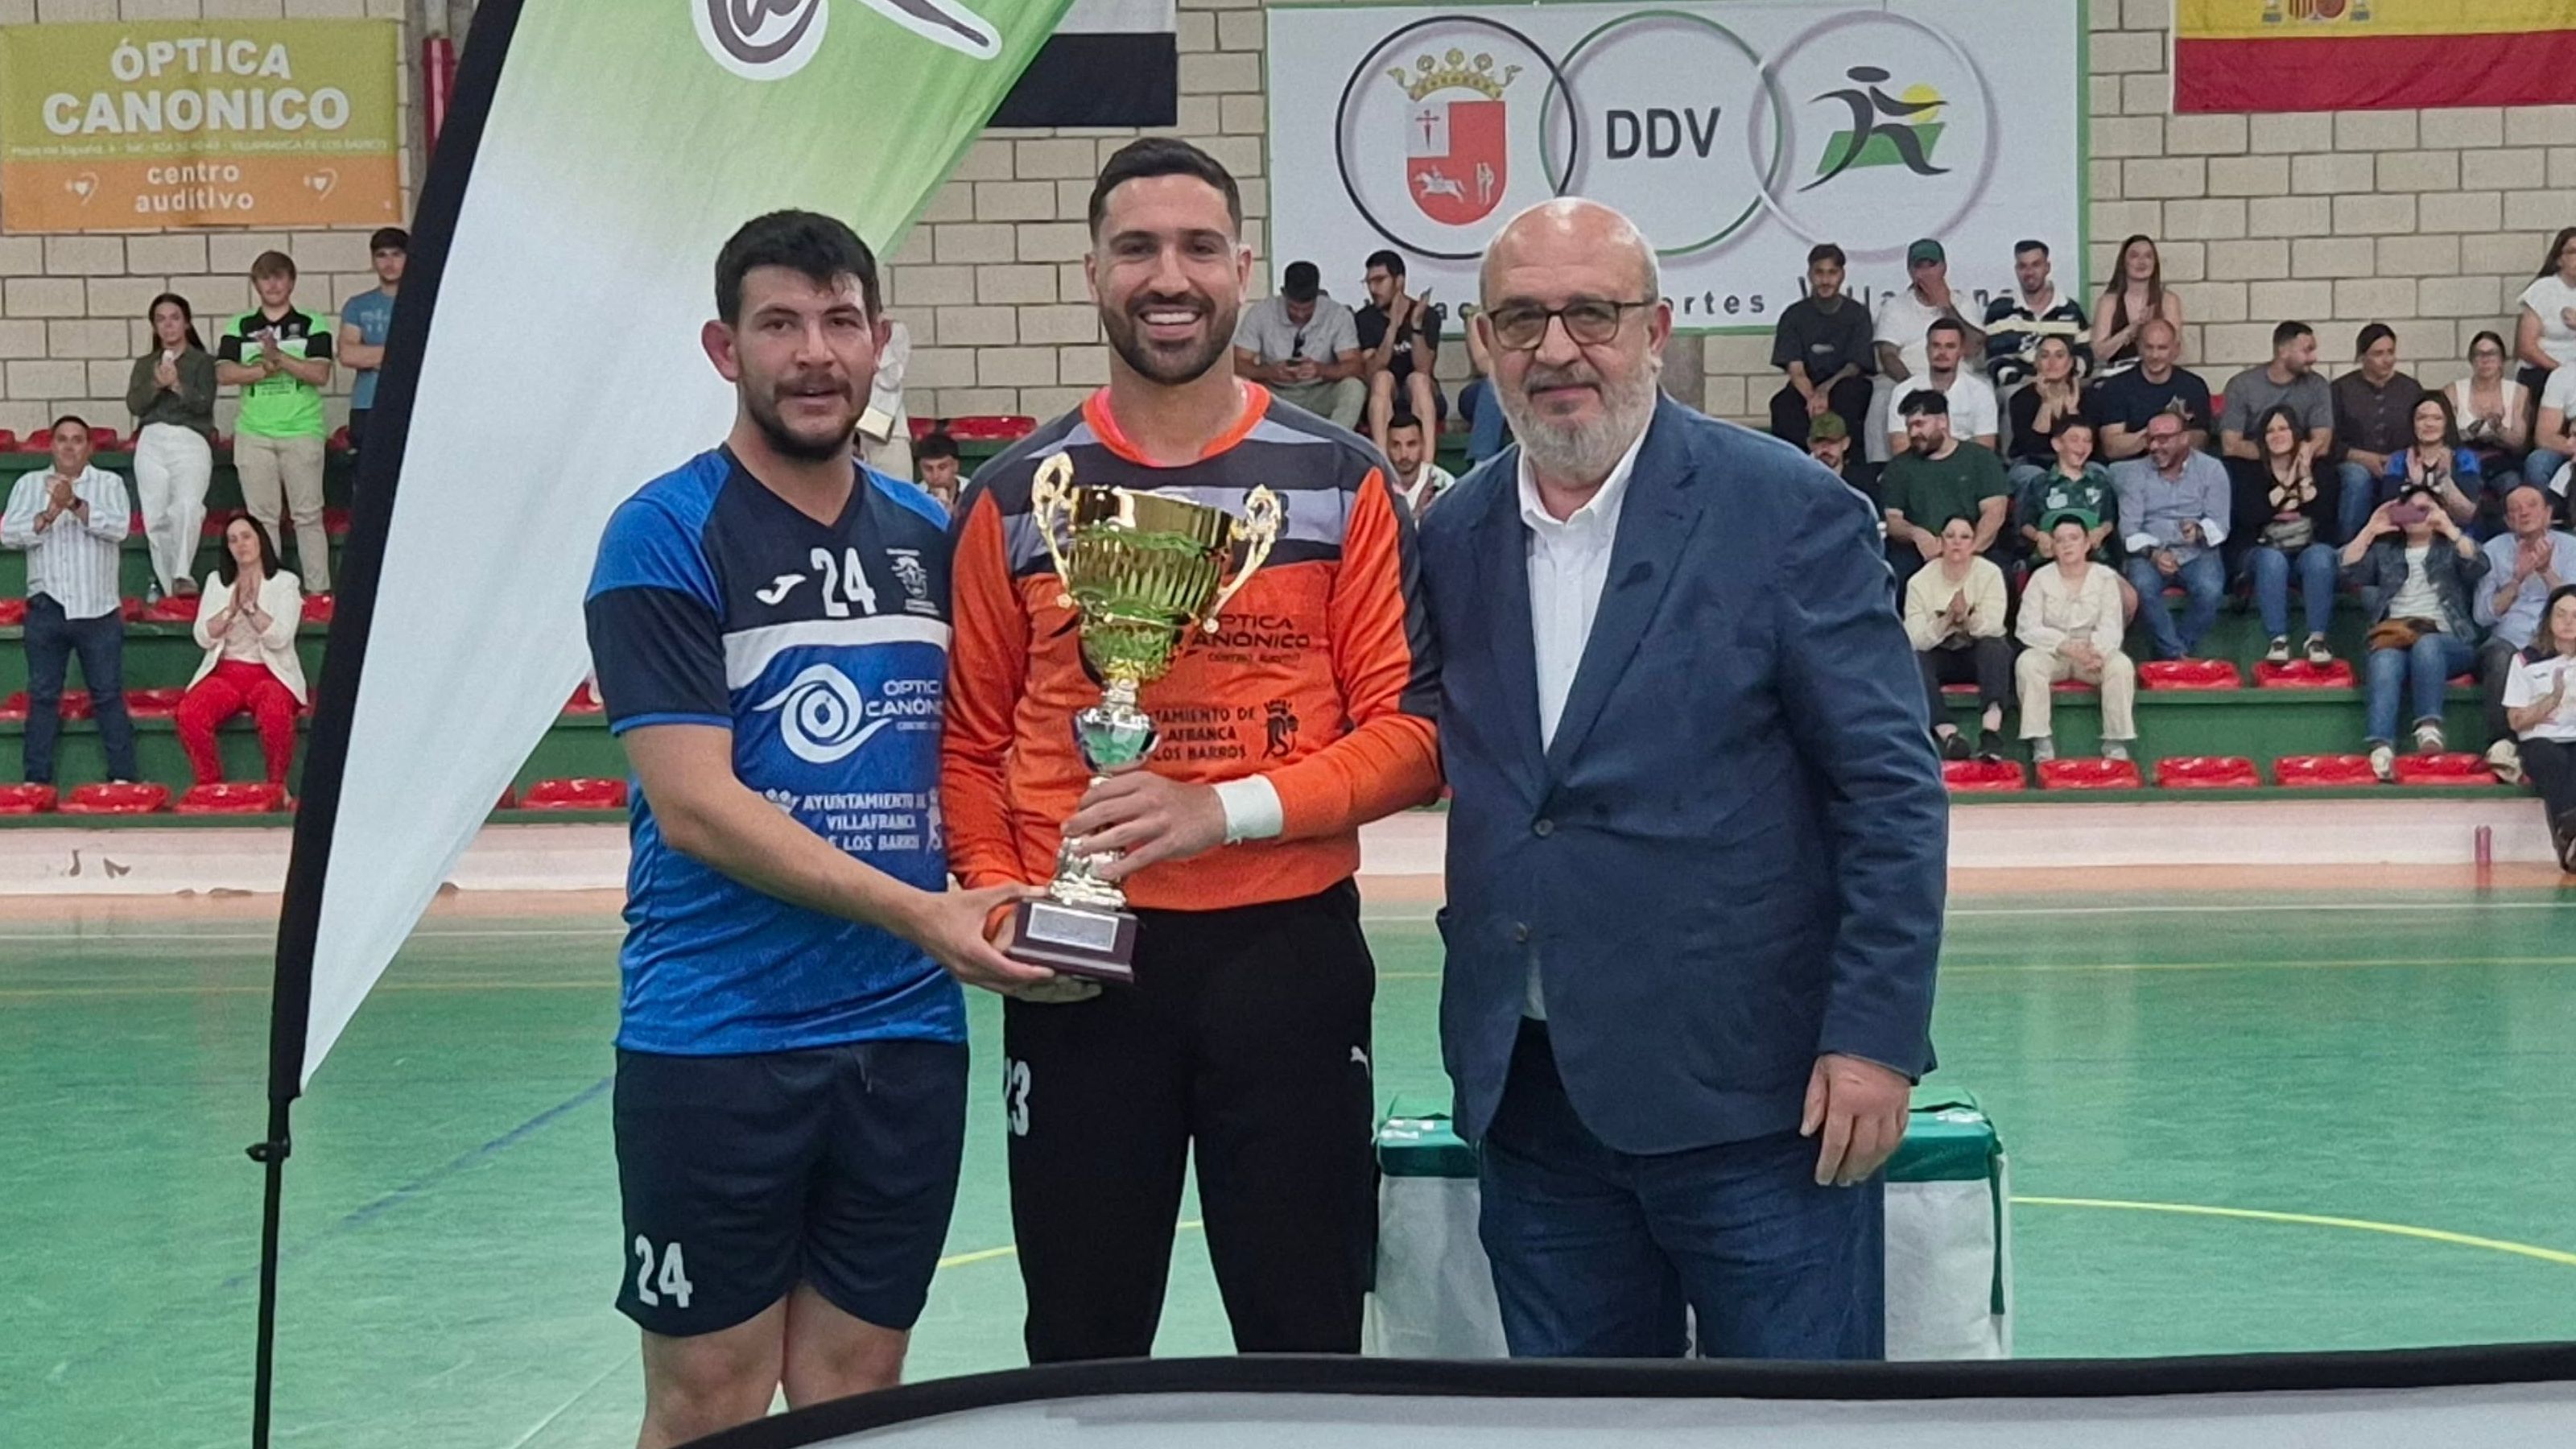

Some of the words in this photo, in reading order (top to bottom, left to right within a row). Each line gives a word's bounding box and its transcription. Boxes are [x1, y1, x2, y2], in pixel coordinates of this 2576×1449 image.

[111, 37, 291, 80] ÓPTICA
[43, 87, 350, 134] CANONICO
[1606, 107, 1721, 160] DDV
[148, 163, 240, 185] centro
[135, 189, 254, 213] auditivo
[810, 547, 878, 617] 24
[1220, 613, 1294, 630] PTICA
[843, 833, 873, 852] LOS
[635, 1233, 693, 1309] 24
